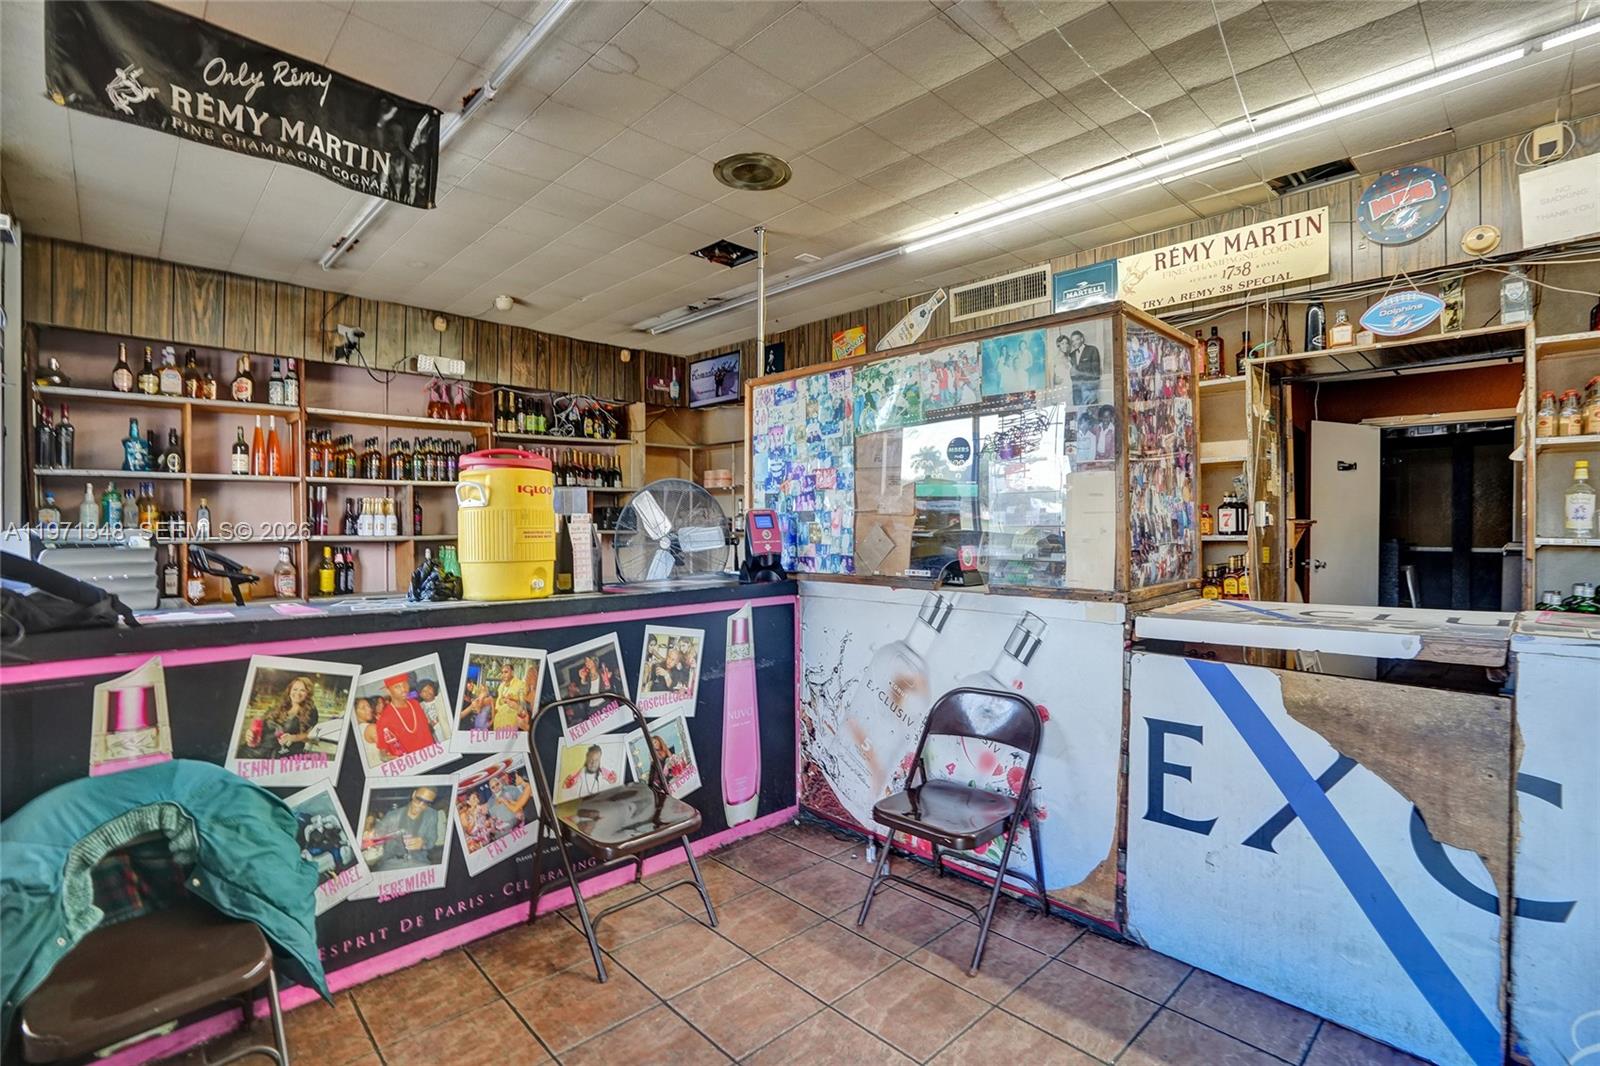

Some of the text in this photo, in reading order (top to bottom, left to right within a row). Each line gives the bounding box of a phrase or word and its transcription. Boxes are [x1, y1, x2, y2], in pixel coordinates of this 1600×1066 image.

[203, 57, 265, 102] Only
[171, 115, 215, 140] FINE
[222, 132, 327, 172] CHAMPAGNE
[279, 116, 391, 175] MARTIN
[1154, 213, 1323, 272] RÉMY MARTIN
[1189, 251, 1258, 275] CHAMPAGNE
[1262, 238, 1313, 257] COGNAC
[1221, 262, 1251, 281] 1738
[1066, 285, 1103, 299] MARTELL
[1142, 271, 1294, 311] TRY A REMY 38 SPECIAL
[1378, 303, 1424, 317] Dolphins
[517, 485, 552, 497] IGLOO
[280, 751, 328, 774] RIVERA
[380, 741, 444, 777] FABOLOUS
[487, 825, 529, 858] FAT JOE
[400, 914, 425, 933] DE
[434, 894, 484, 921] PARIS
[503, 856, 597, 896] CELBRAING
